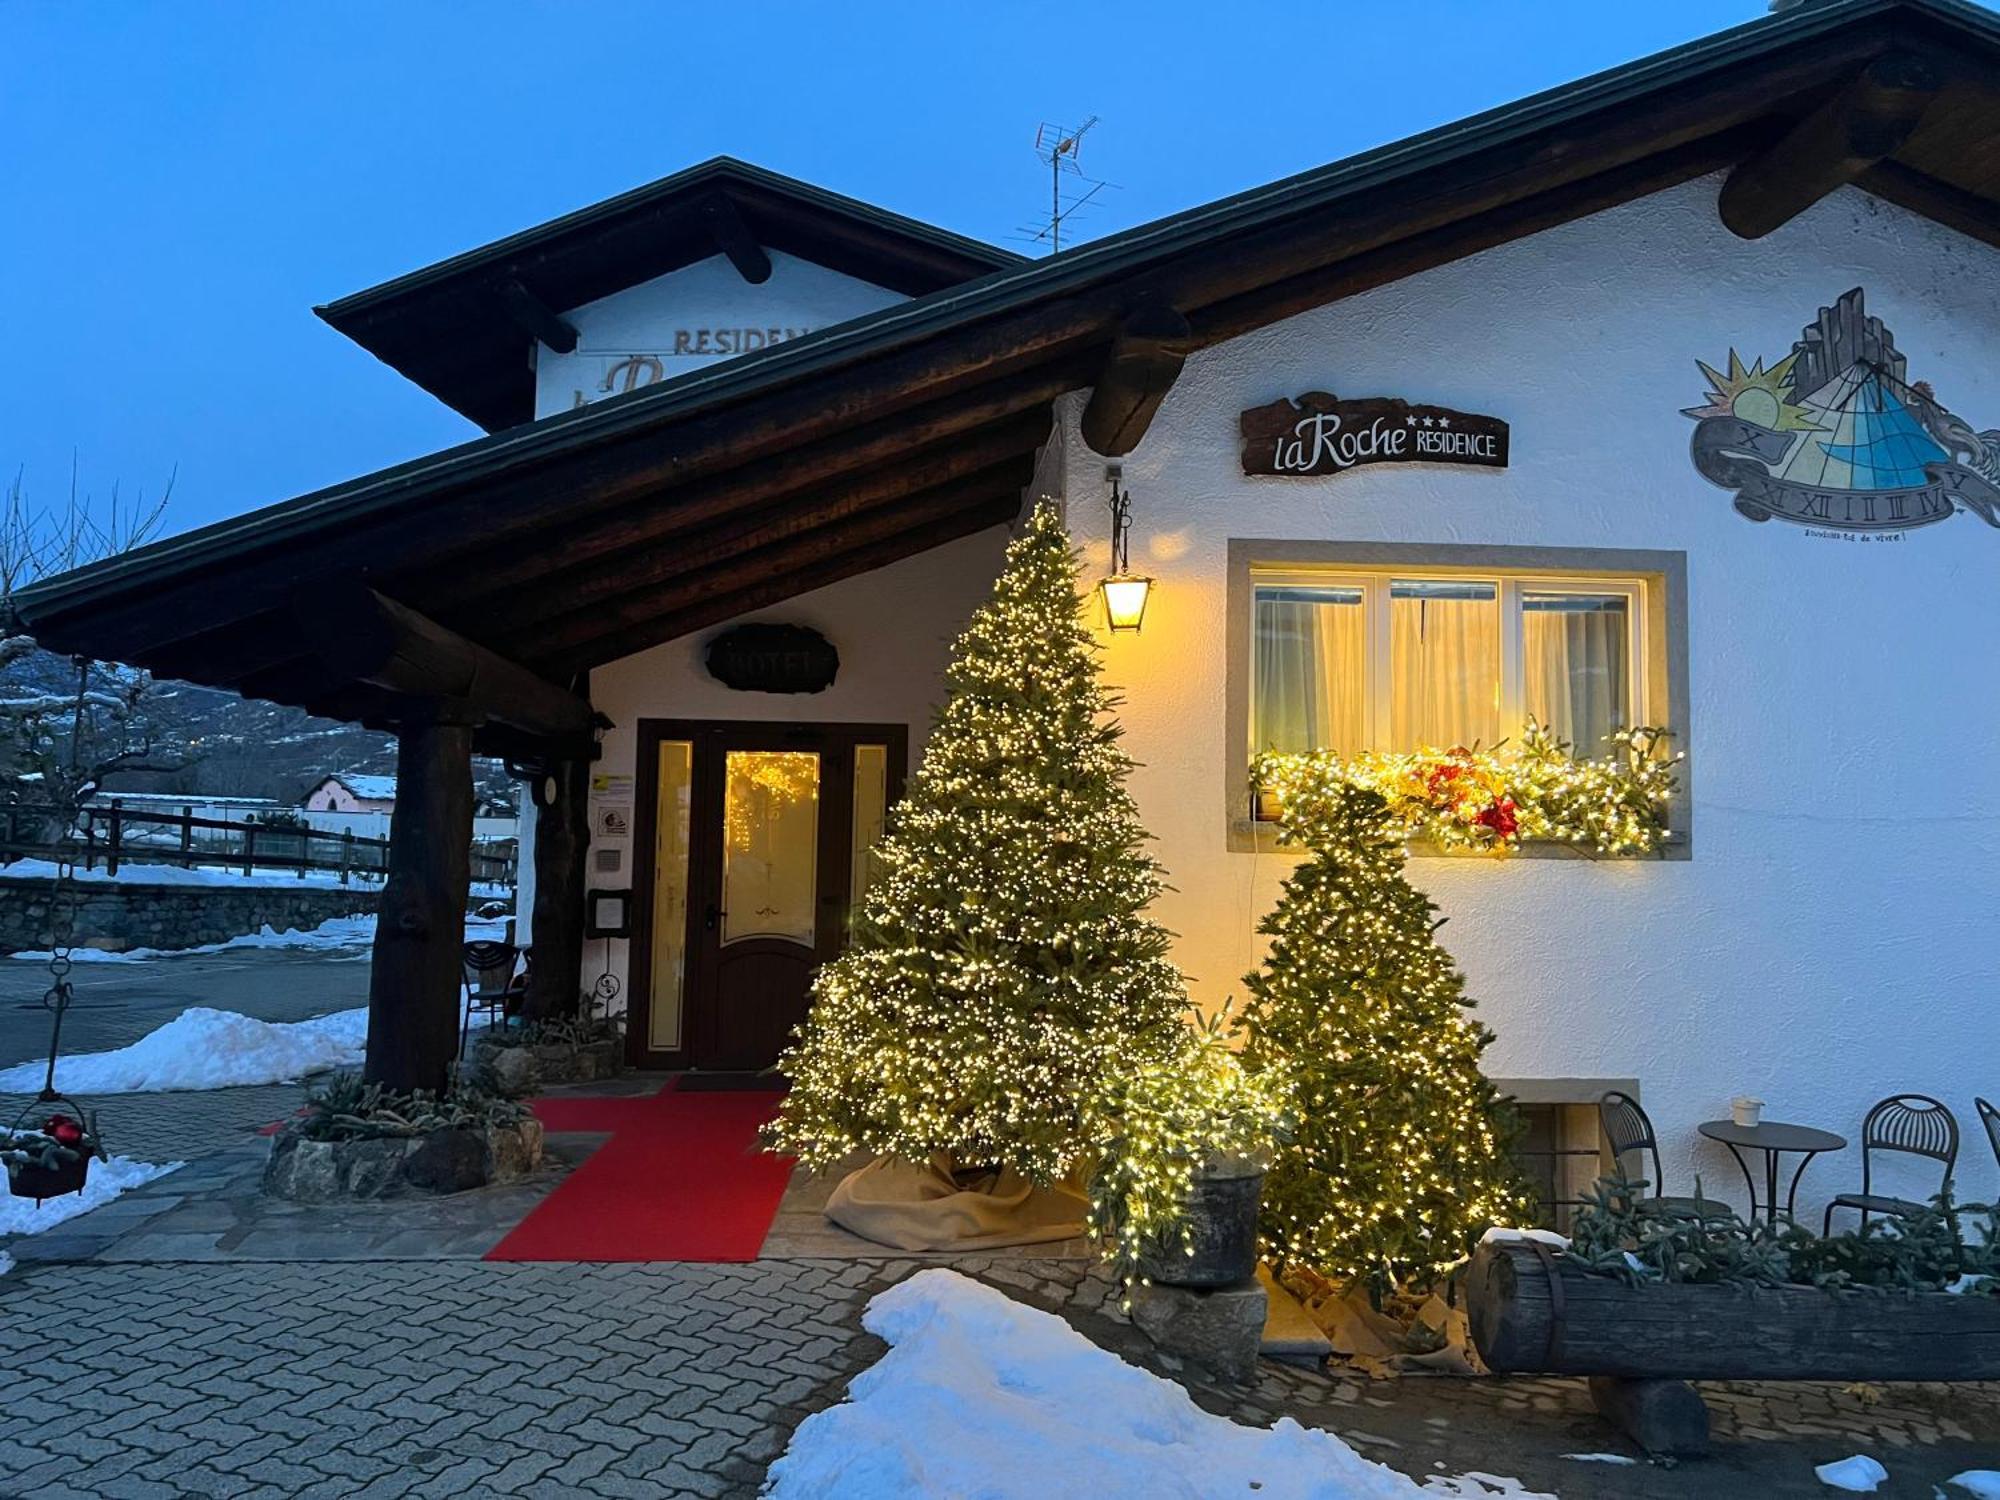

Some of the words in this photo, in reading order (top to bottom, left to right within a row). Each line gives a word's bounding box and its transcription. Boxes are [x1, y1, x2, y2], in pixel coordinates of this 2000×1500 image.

[1294, 413, 1408, 472] Roche
[1416, 430, 1498, 458] RESIDENCE
[1739, 427, 1763, 451] X
[1760, 482, 1784, 507] XI
[1799, 492, 1832, 518] XII
[1862, 497, 1877, 521] II
[1886, 496, 1909, 519] III
[1918, 488, 1942, 516] IV
[1947, 471, 1970, 490] V
